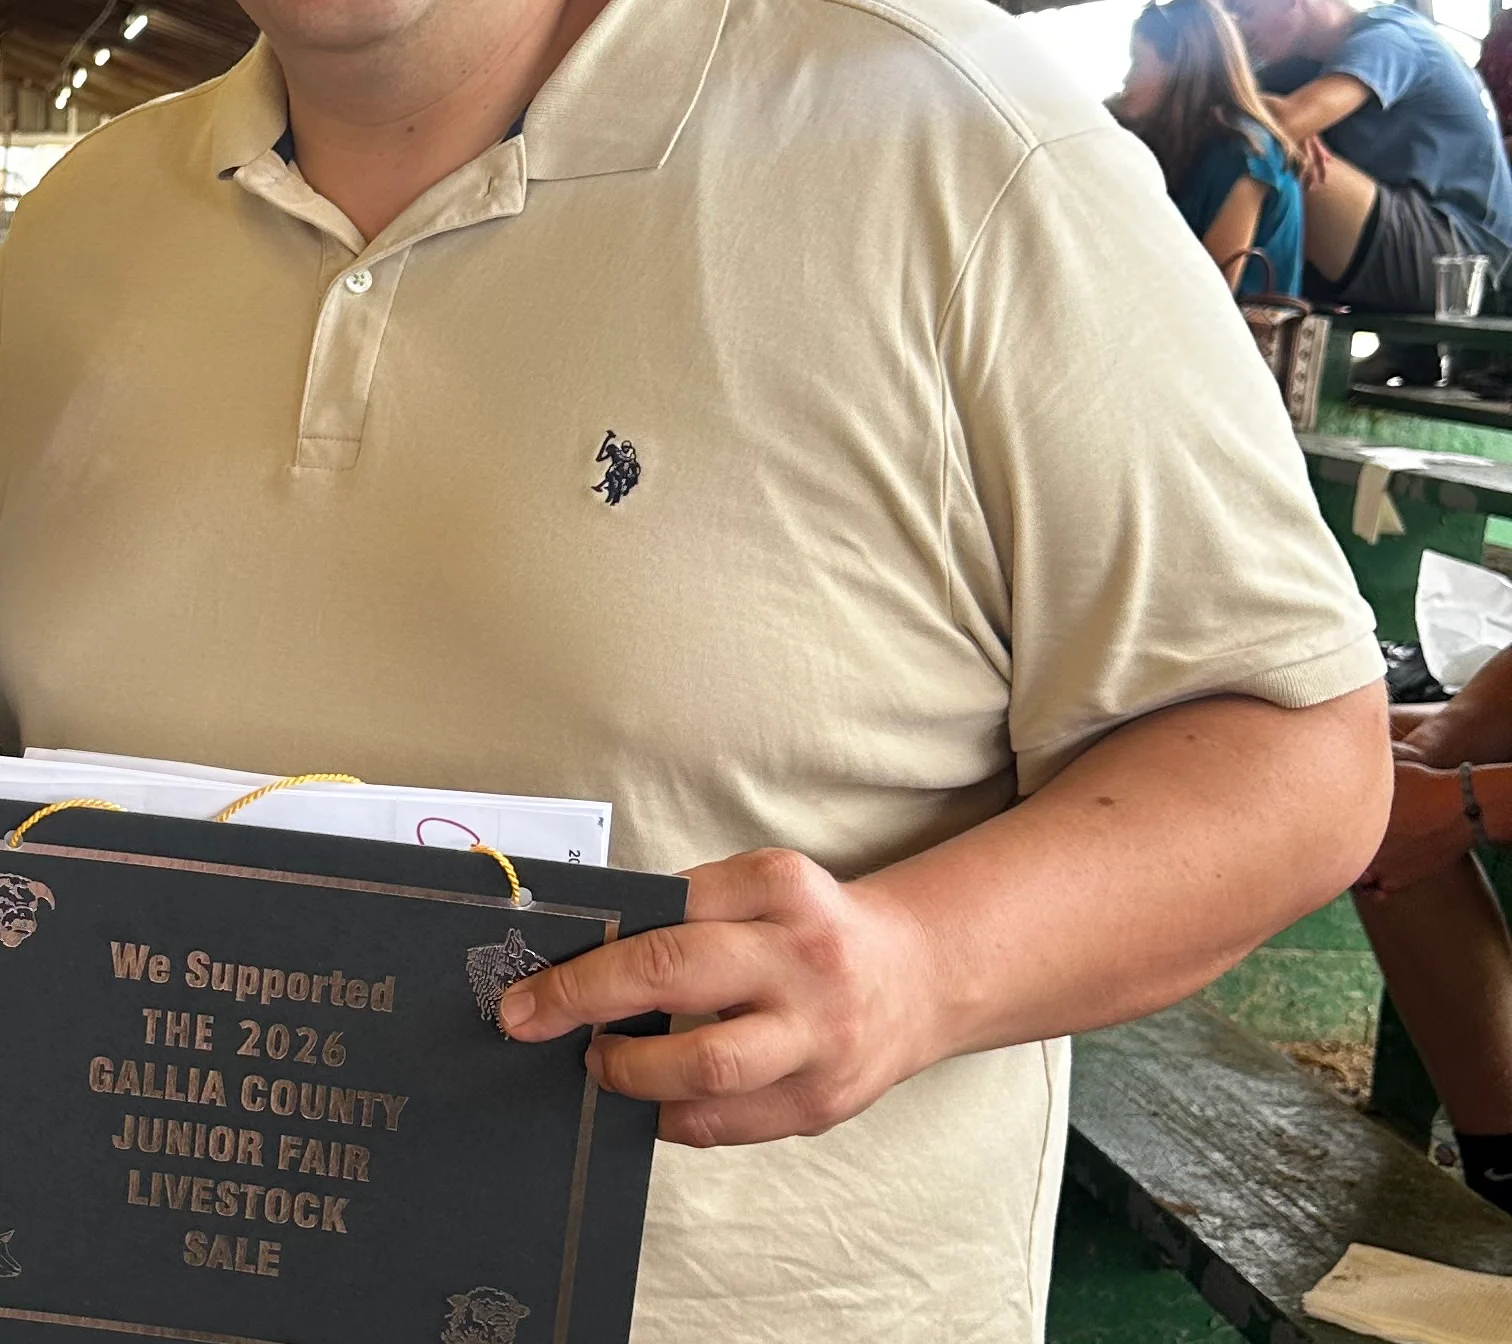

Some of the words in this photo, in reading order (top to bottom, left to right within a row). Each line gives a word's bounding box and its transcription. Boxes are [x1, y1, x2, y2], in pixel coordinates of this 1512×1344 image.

[110, 941, 170, 984] We
[185, 950, 396, 1012] Supported
[143, 1008, 214, 1051] THE
[237, 1019, 346, 1067] 2026
[88, 1056, 227, 1107] GALLIA
[241, 1074, 409, 1131] COUNTY
[112, 1114, 264, 1167] JUNIOR
[278, 1134, 370, 1182] FAIR
[128, 1169, 350, 1234] LIVESTOCK
[183, 1231, 282, 1277] SALE
